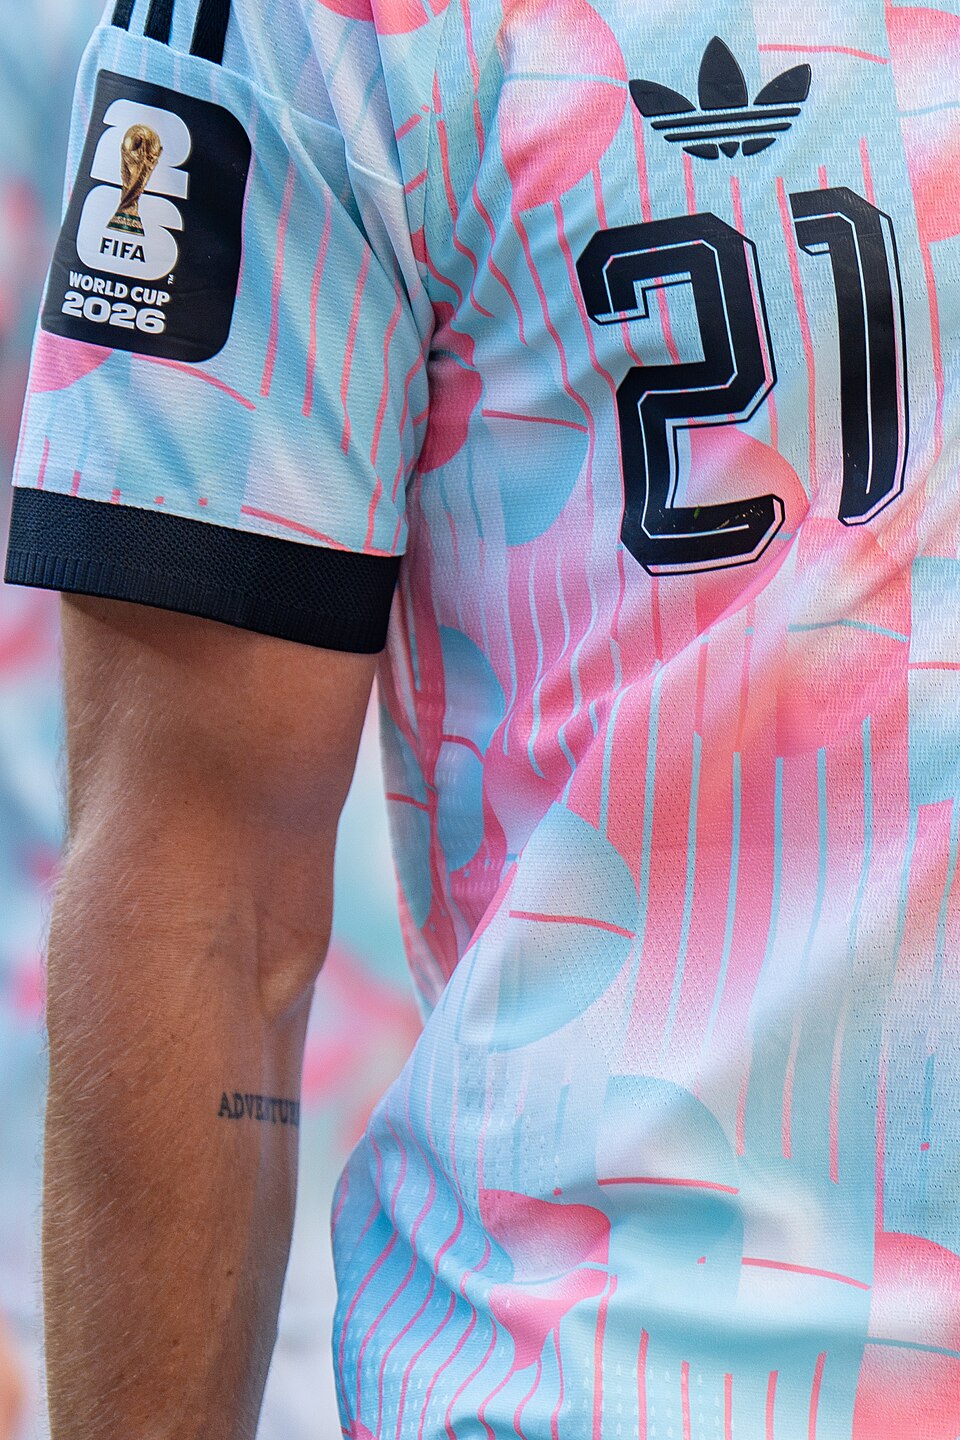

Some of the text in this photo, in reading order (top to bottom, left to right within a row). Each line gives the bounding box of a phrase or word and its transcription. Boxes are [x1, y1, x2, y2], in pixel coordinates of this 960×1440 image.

[99, 237, 146, 263] FIFA
[69, 270, 170, 307] WORLD CUP
[61, 290, 166, 334] 2026
[576, 186, 909, 577] 21
